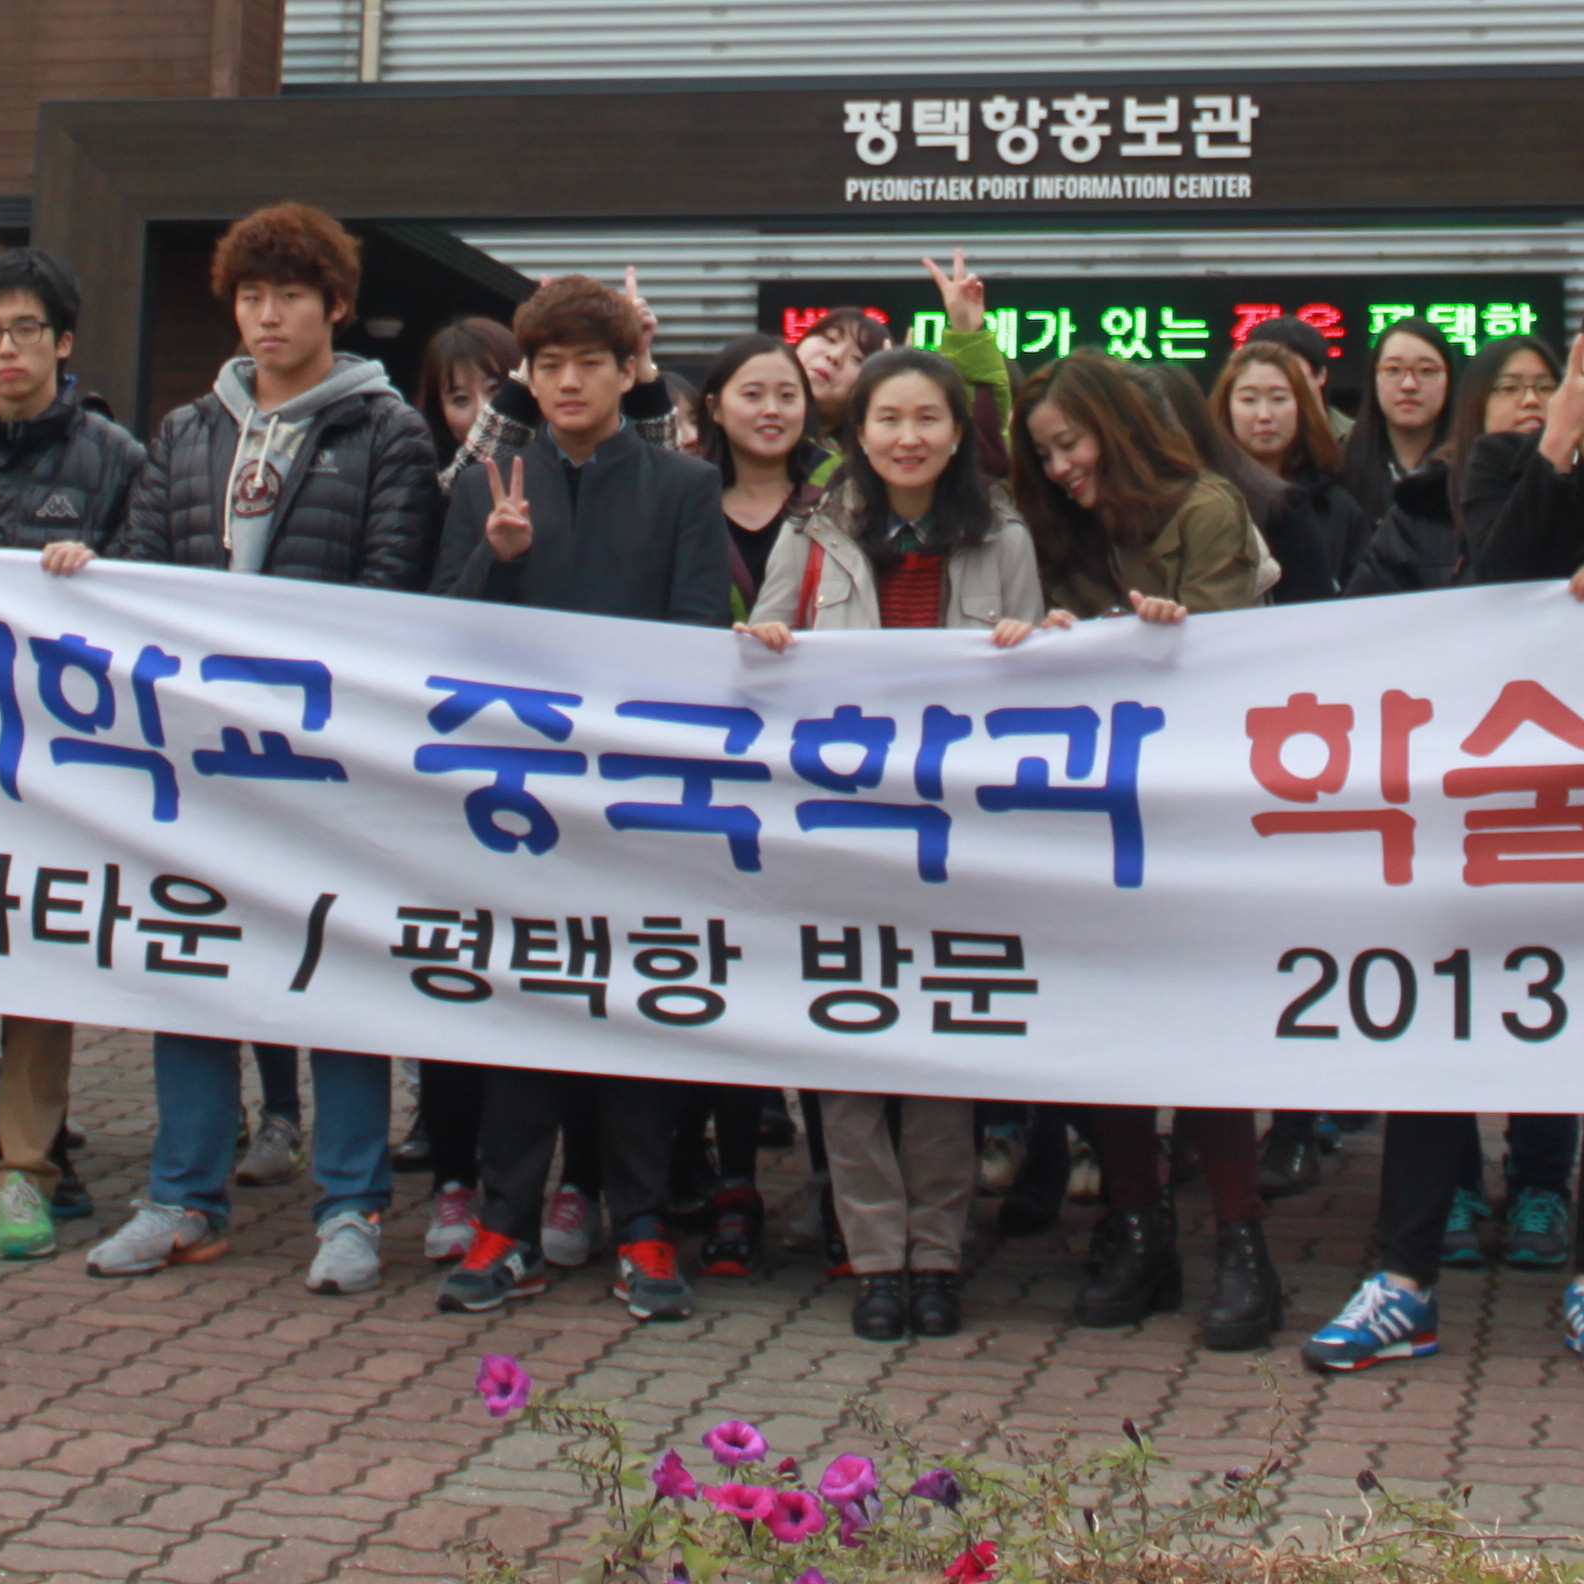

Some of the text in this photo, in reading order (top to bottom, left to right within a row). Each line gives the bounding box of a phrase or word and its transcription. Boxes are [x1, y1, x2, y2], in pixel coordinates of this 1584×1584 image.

[843, 93, 1260, 165] 평택항홍보관
[845, 174, 1252, 202] PYEONGTAEK PORT INFORMATION CENTER
[1101, 306, 1210, 360] 있는
[414, 675, 1166, 889] 중국학과
[389, 906, 743, 1027] 평택항
[800, 924, 1039, 1036] 방문
